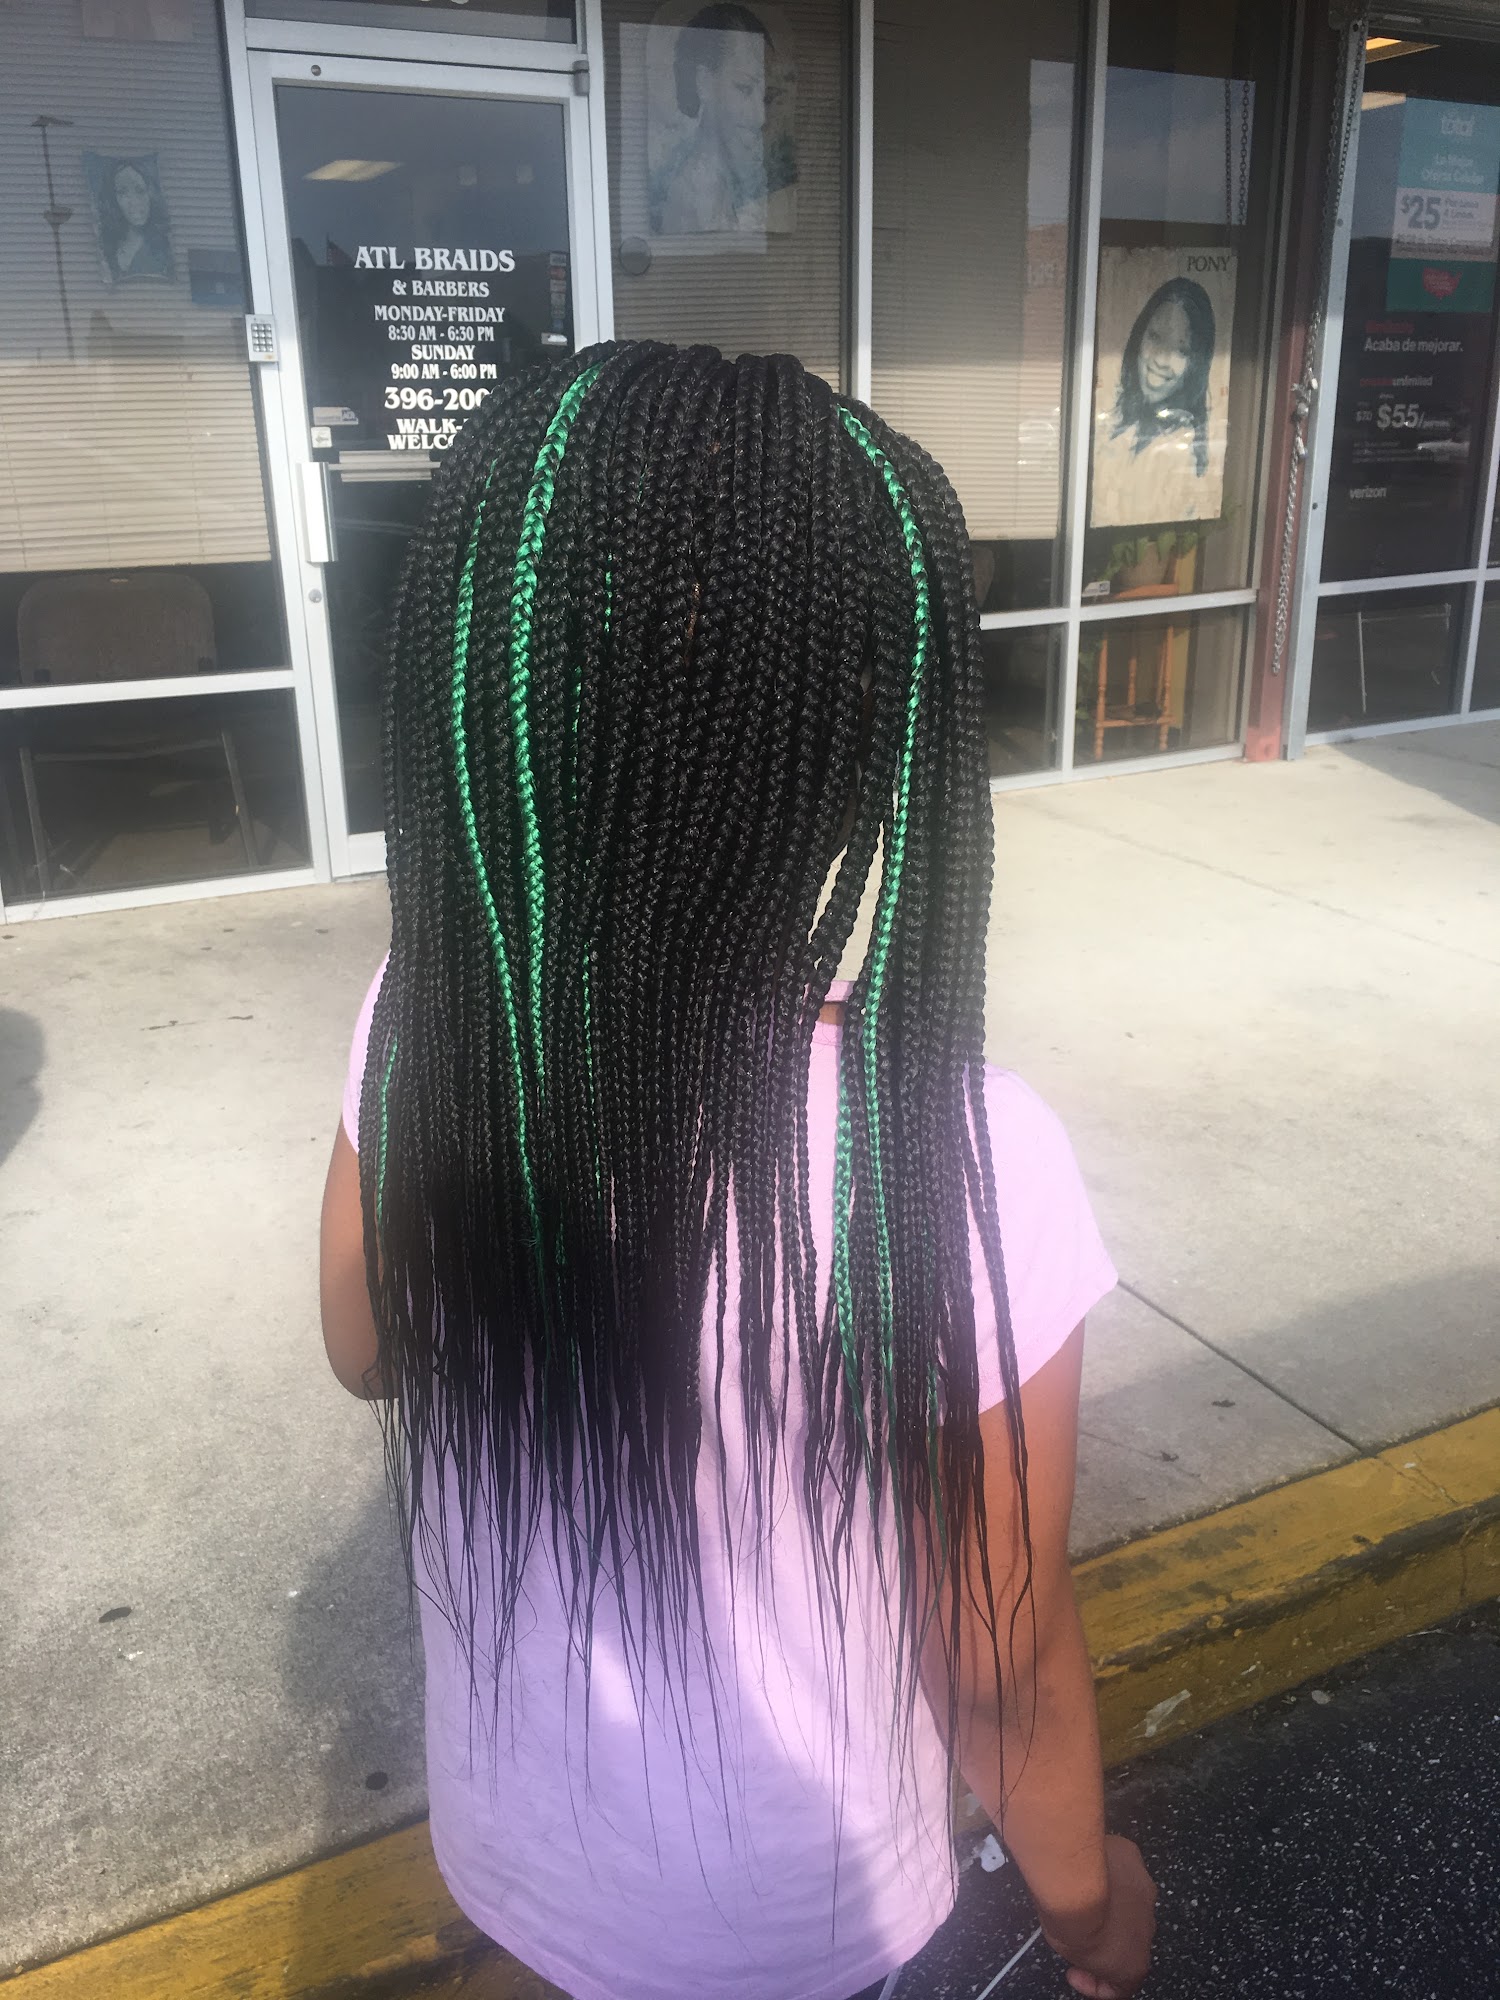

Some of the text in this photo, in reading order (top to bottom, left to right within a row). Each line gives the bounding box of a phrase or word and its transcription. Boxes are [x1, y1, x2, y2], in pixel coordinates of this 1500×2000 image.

[1400, 194, 1441, 231] $25
[354, 246, 516, 272] ATL BRAIDS
[1187, 255, 1231, 272] PONY
[392, 280, 490, 298] & BARBERS
[374, 305, 506, 323] MONDAY-FRIDAY
[388, 325, 416, 341] 8:30
[418, 326, 437, 341] AM
[447, 326, 474, 342] 6:30
[477, 326, 495, 342] PM
[411, 344, 476, 361] SUNDAY
[1364, 337, 1401, 352] Acaba
[1402, 337, 1417, 352] de
[391, 363, 419, 380] 9:00
[421, 363, 441, 380] AM
[449, 363, 478, 380] 6:00
[480, 364, 498, 380] PM
[395, 418, 469, 434] WALK-
[1349, 485, 1388, 500] verizon
